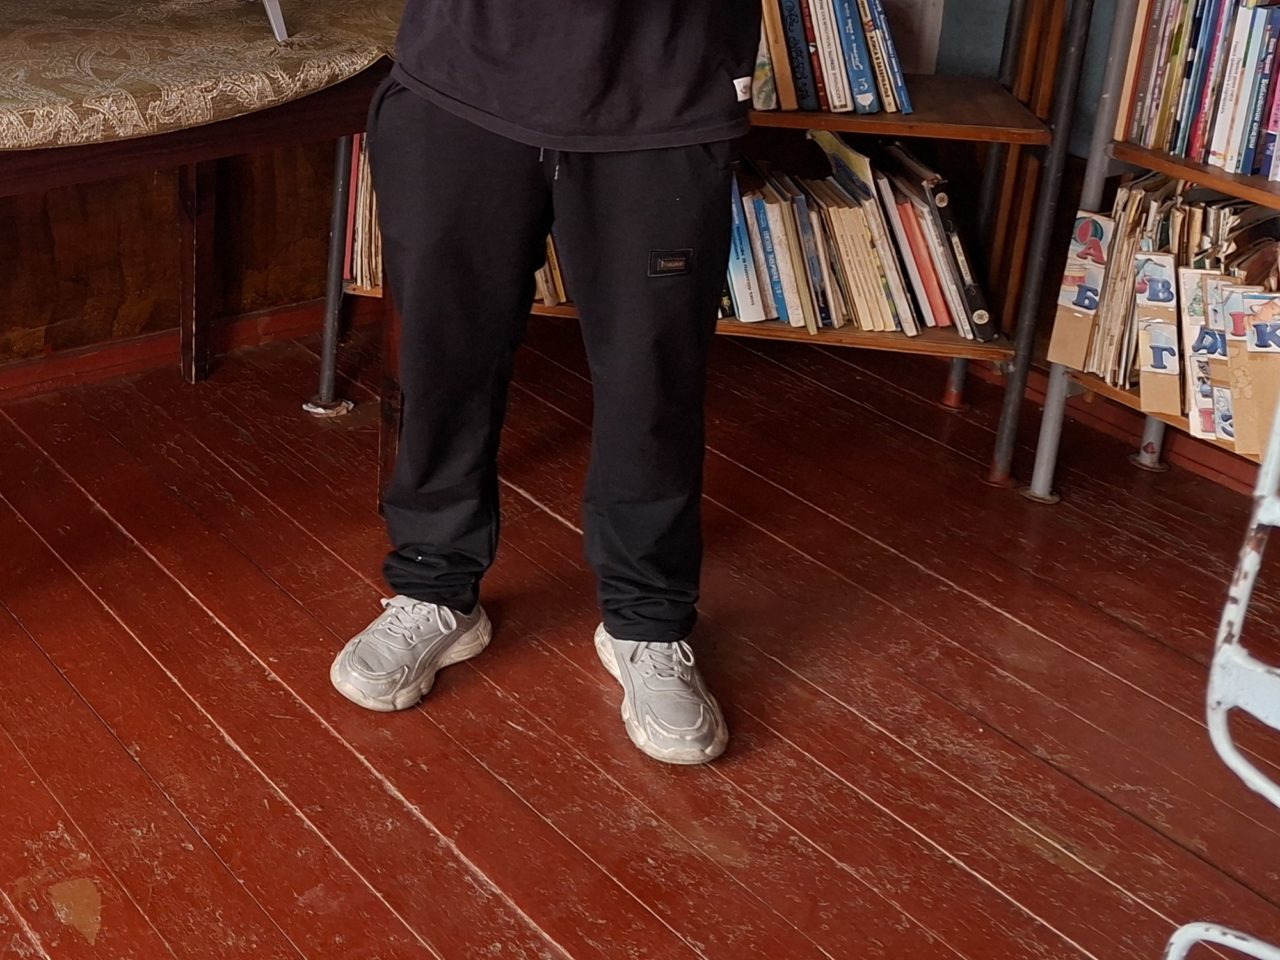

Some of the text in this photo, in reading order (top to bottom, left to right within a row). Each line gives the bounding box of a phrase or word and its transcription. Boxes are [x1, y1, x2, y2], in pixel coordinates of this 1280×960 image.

[1076, 238, 1106, 265] А
[1072, 284, 1099, 310] Б
[1147, 278, 1175, 302] В
[1150, 345, 1176, 370] Г
